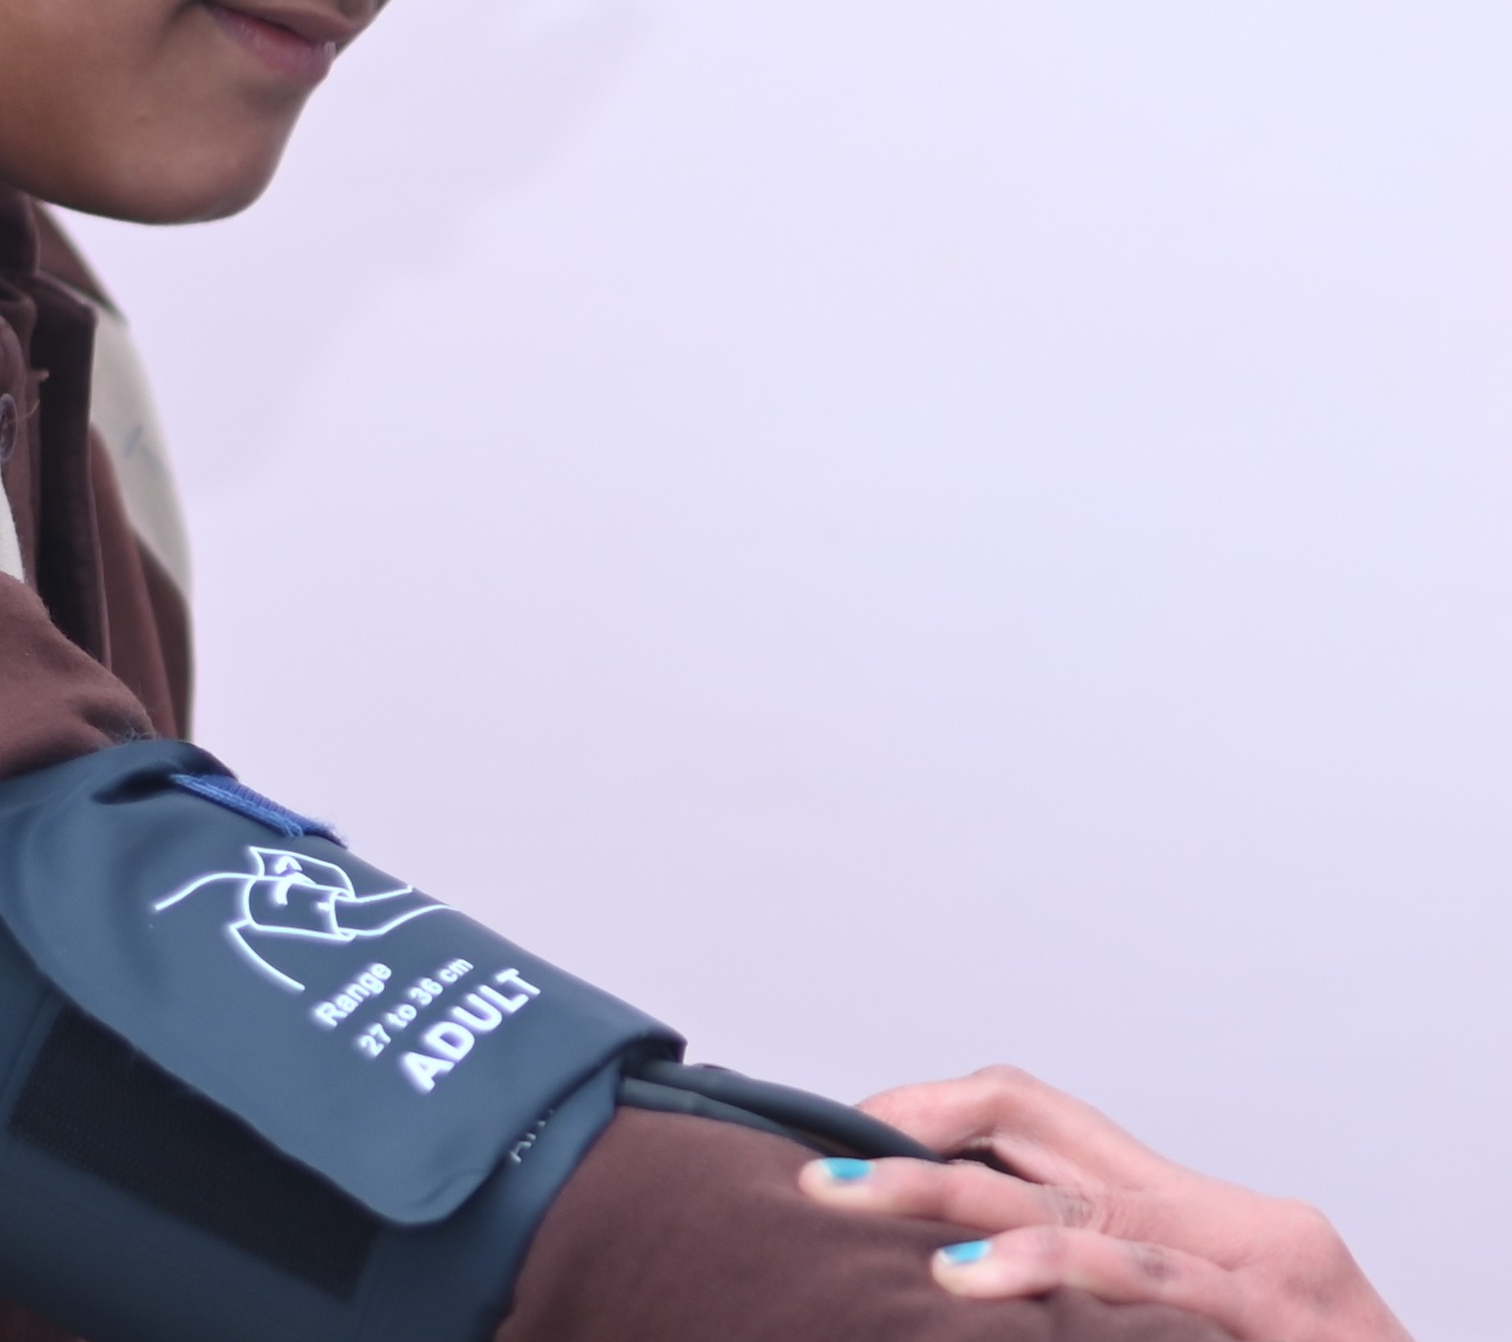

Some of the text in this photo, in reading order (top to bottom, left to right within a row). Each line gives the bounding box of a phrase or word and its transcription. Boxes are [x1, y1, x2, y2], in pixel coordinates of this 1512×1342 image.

[312, 962, 392, 1028] Range
[357, 958, 474, 1057] 27 to 36 cm
[400, 967, 541, 1093] ADULT
